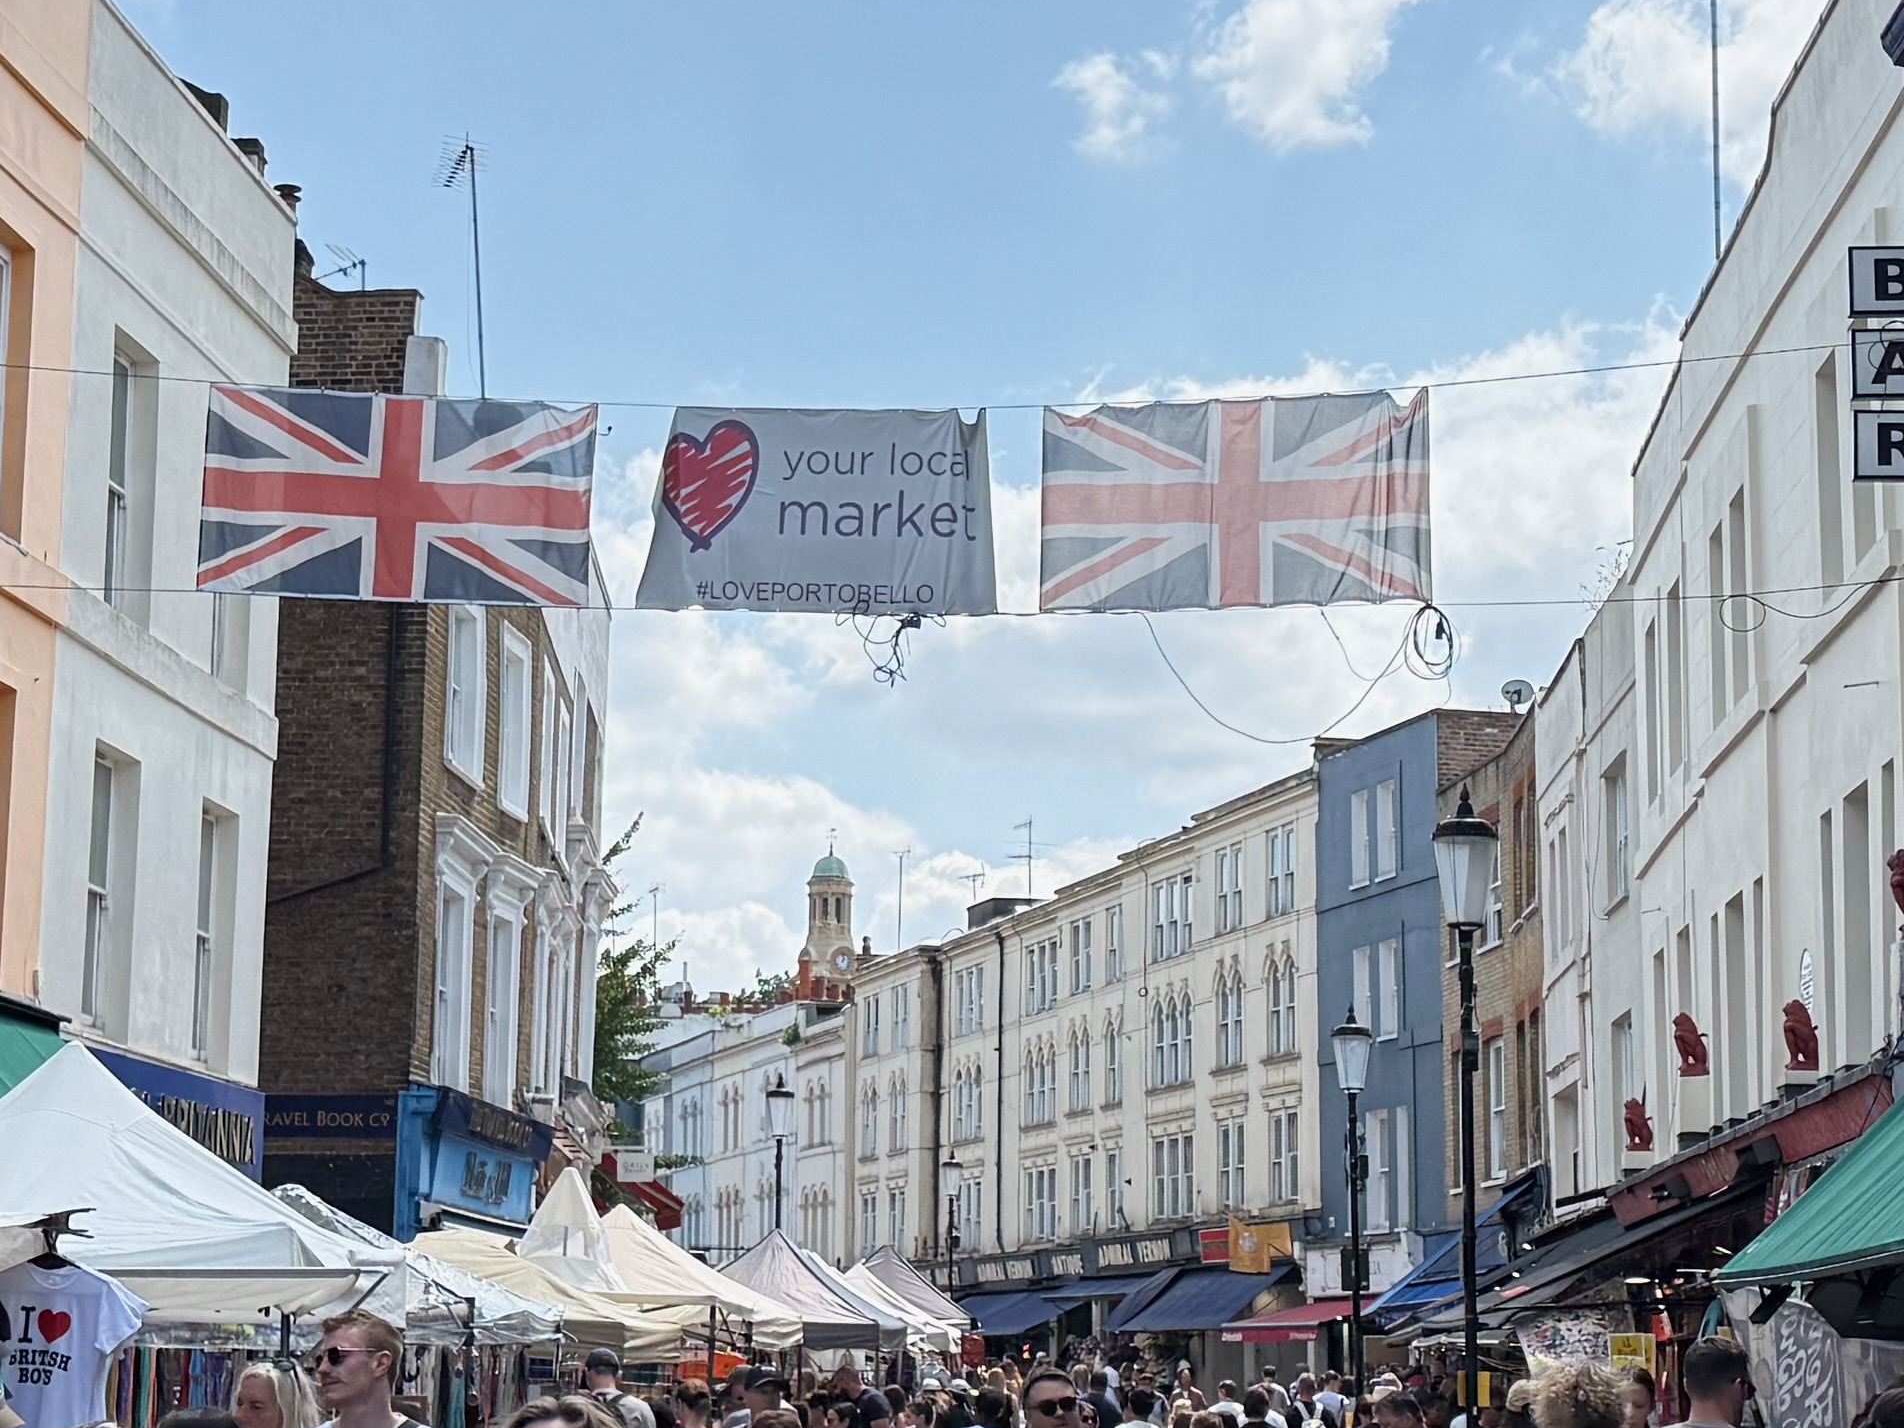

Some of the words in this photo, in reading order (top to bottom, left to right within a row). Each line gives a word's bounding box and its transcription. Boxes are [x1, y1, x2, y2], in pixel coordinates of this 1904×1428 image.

[782, 449, 874, 481] your
[890, 442, 970, 482] local
[778, 490, 976, 542] market
[696, 580, 935, 605] #LOVEPORTOBELLO
[264, 1111, 311, 1128] RAVEL
[18, 1305, 37, 1344] I
